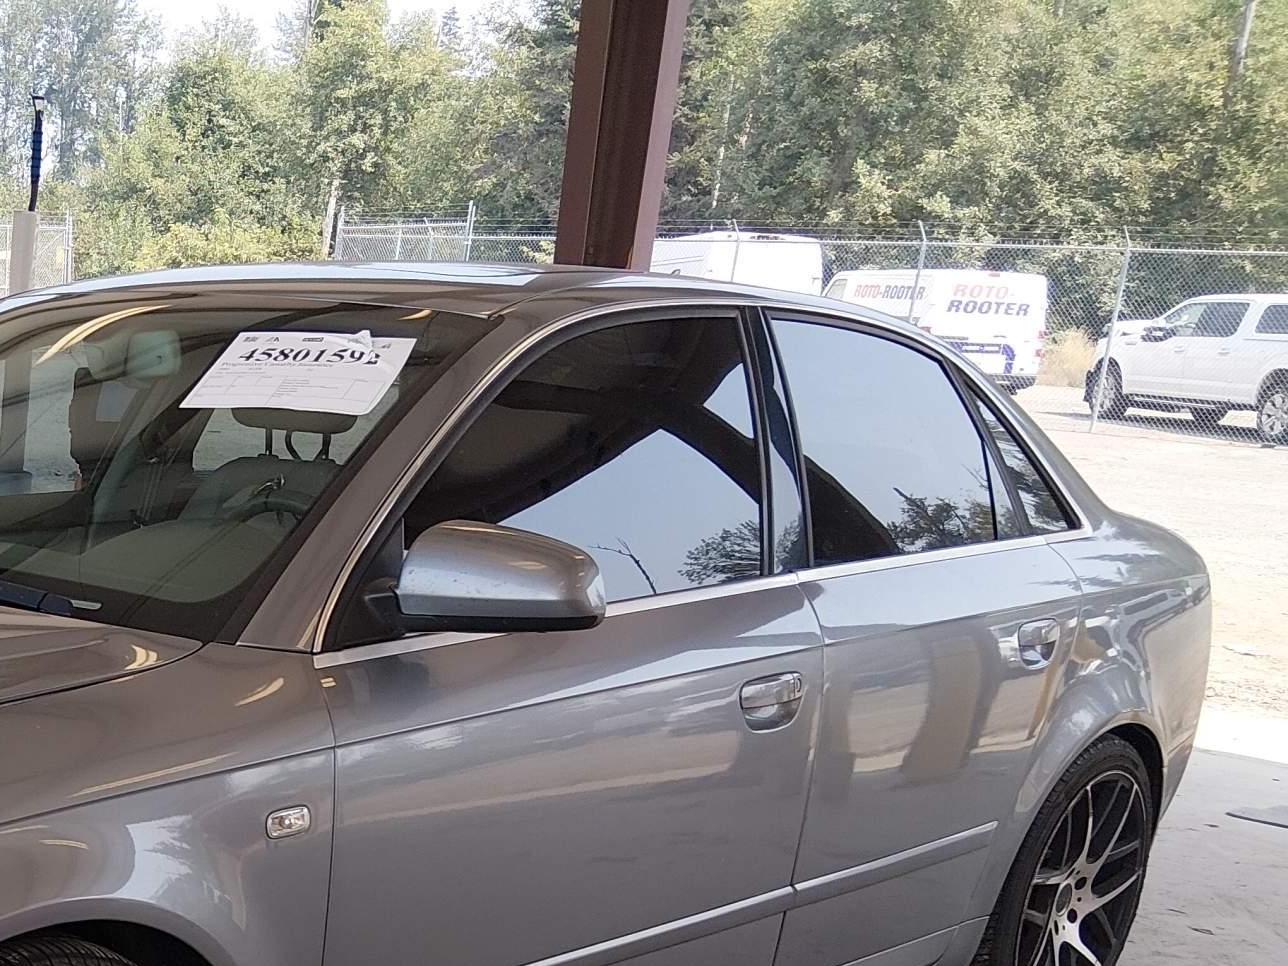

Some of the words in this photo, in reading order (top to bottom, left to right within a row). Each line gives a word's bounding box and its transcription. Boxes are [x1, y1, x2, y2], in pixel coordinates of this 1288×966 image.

[952, 283, 1016, 299] ROTO-
[946, 299, 1030, 317] ROOTER
[238, 347, 381, 365] 45801592
